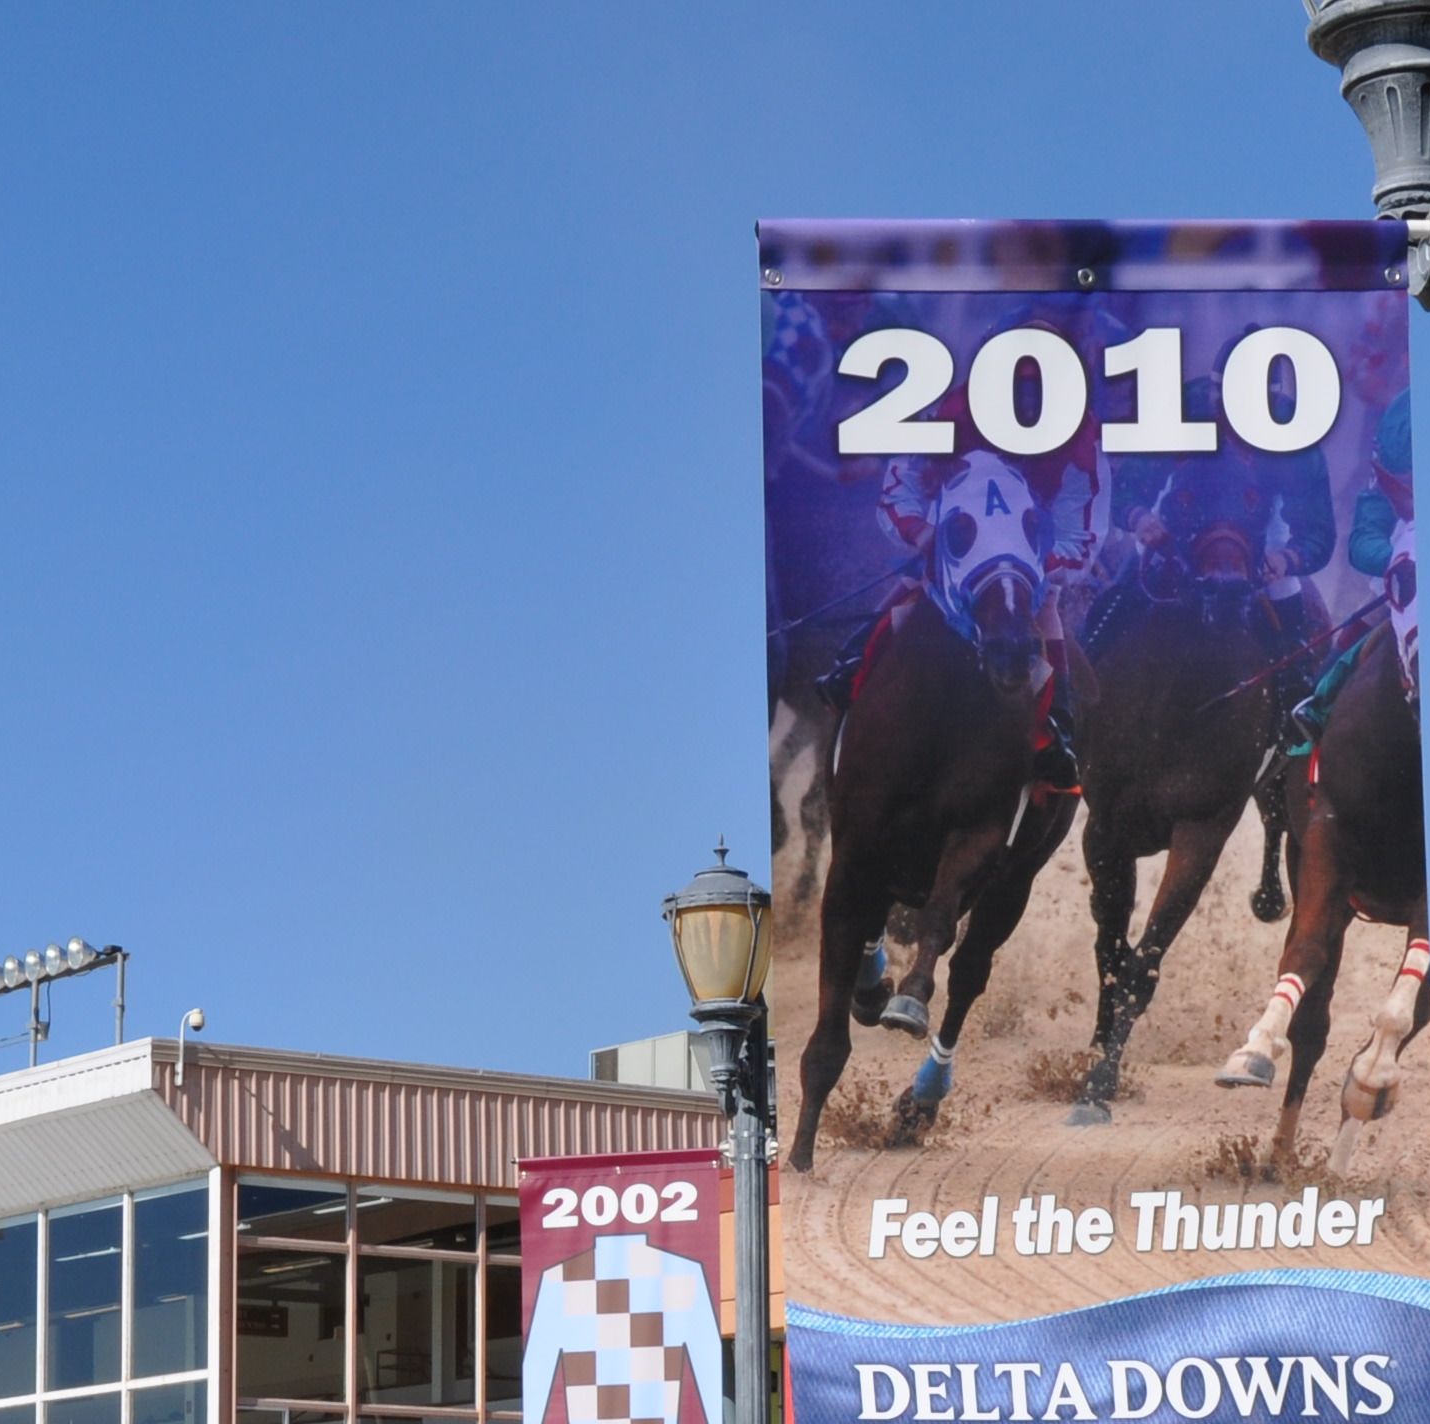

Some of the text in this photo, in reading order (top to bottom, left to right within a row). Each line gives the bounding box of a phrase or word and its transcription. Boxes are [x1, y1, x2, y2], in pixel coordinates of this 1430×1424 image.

[837, 326, 1342, 455] 2010
[542, 1181, 698, 1229] 2002
[868, 1186, 1385, 1259] Feel the Thunder
[856, 1355, 1395, 1421] DELTA DOWNS
